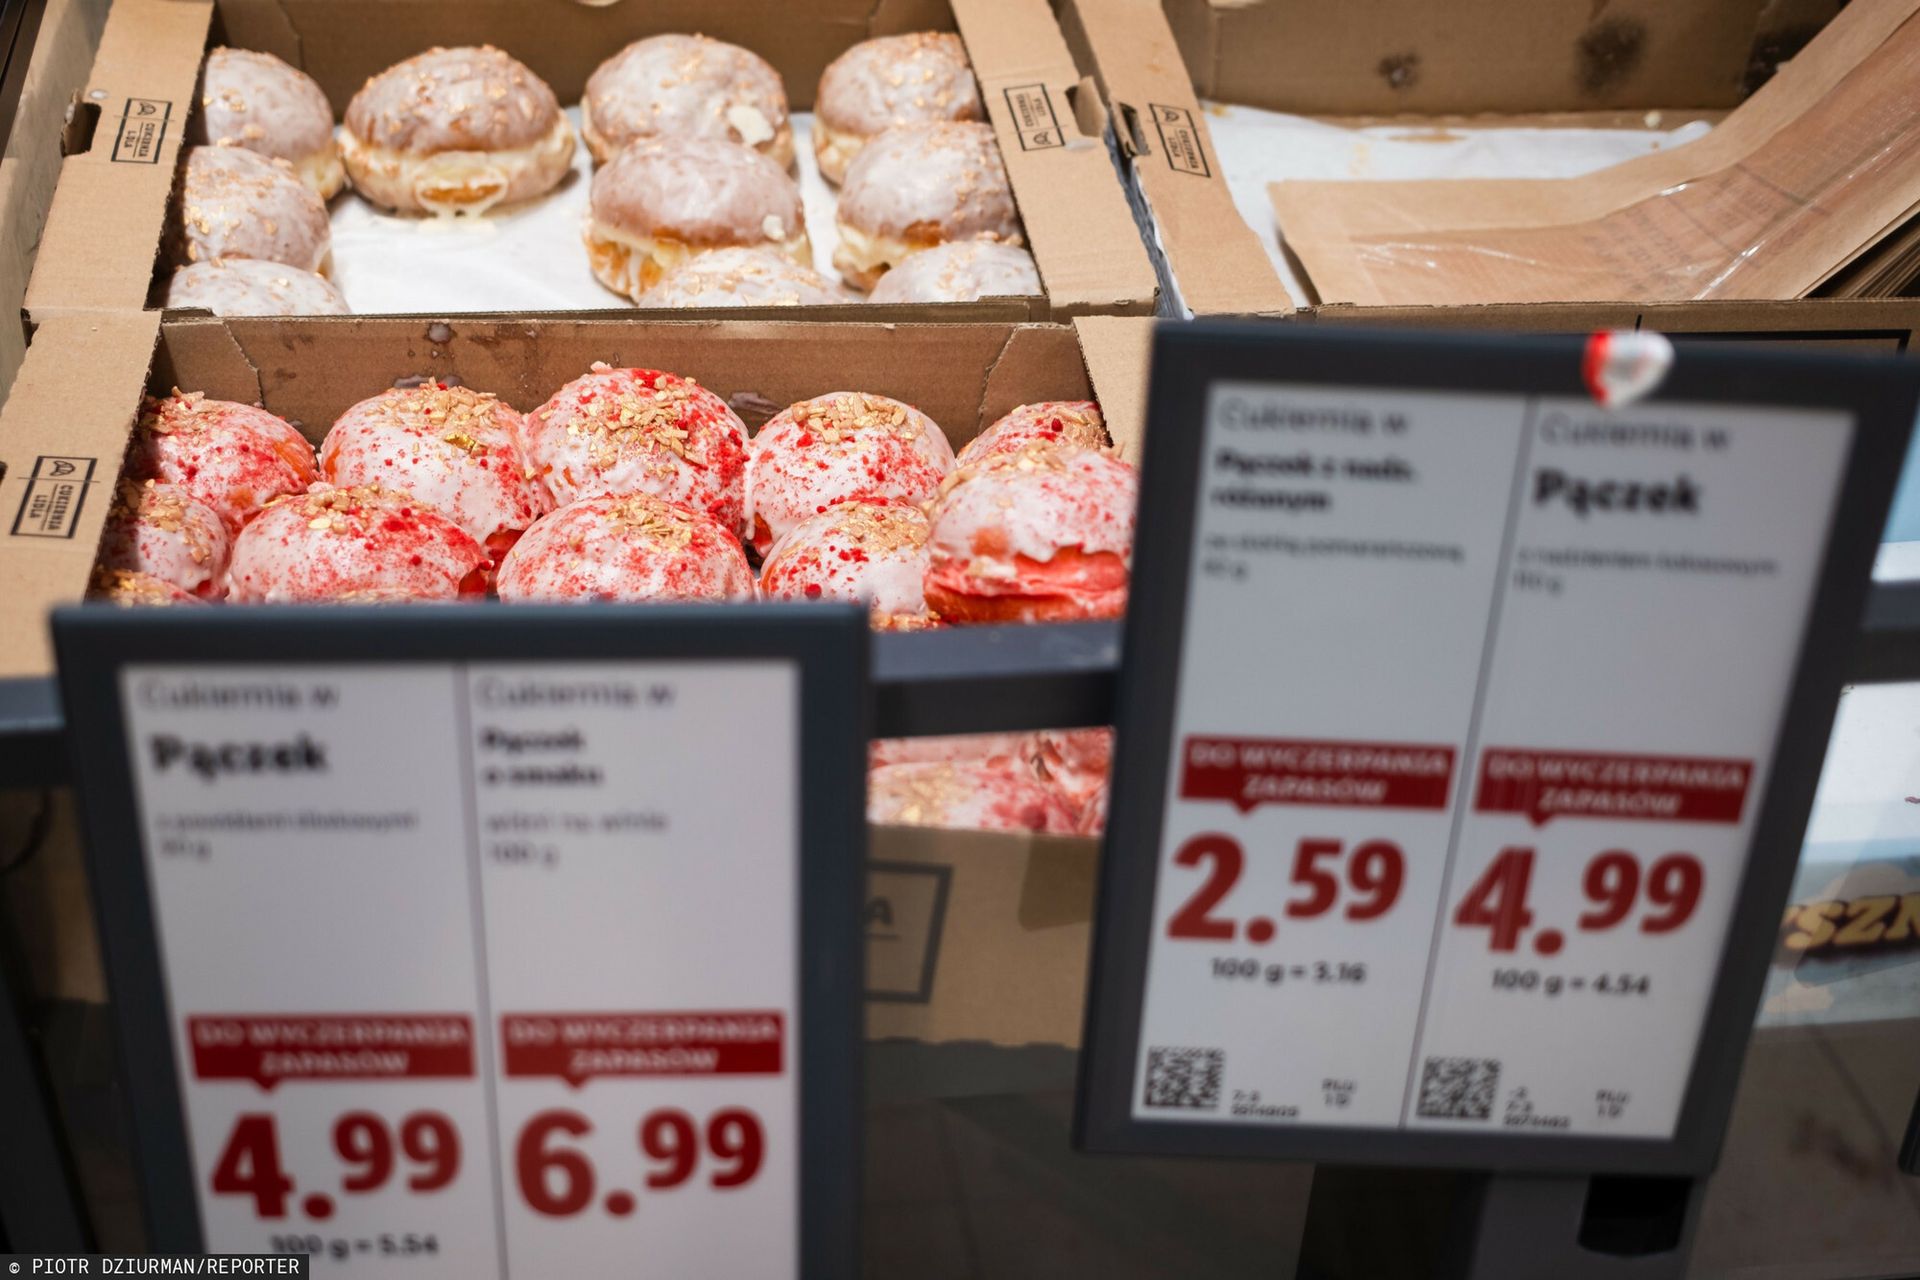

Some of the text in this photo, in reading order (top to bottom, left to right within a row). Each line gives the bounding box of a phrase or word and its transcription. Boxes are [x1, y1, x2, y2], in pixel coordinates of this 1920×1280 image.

[48, 484, 74, 530] CUKIERNIA
[1535, 468, 1700, 518] Pączek
[150, 731, 328, 781] Pączek
[1190, 743, 1447, 773] DO WYCZERPANIA
[1489, 756, 1743, 787] DO WYCZERPANIA
[1167, 831, 1406, 944] 2.59
[1454, 847, 1706, 957] 4.99
[1211, 955, 1259, 980] 100
[1265, 963, 1284, 985] g
[1314, 962, 1366, 984] 3.16
[1491, 966, 1539, 990] 100
[1545, 973, 1564, 997] g
[1594, 971, 1650, 996] 4.54
[250, 1022, 464, 1045] WYCZERPANIA
[564, 1019, 776, 1043] WYCZERPANIA
[211, 1109, 462, 1221] 4.99
[515, 1107, 766, 1218] 6.99
[329, 1237, 349, 1260] g
[379, 1234, 438, 1256] 5.54
